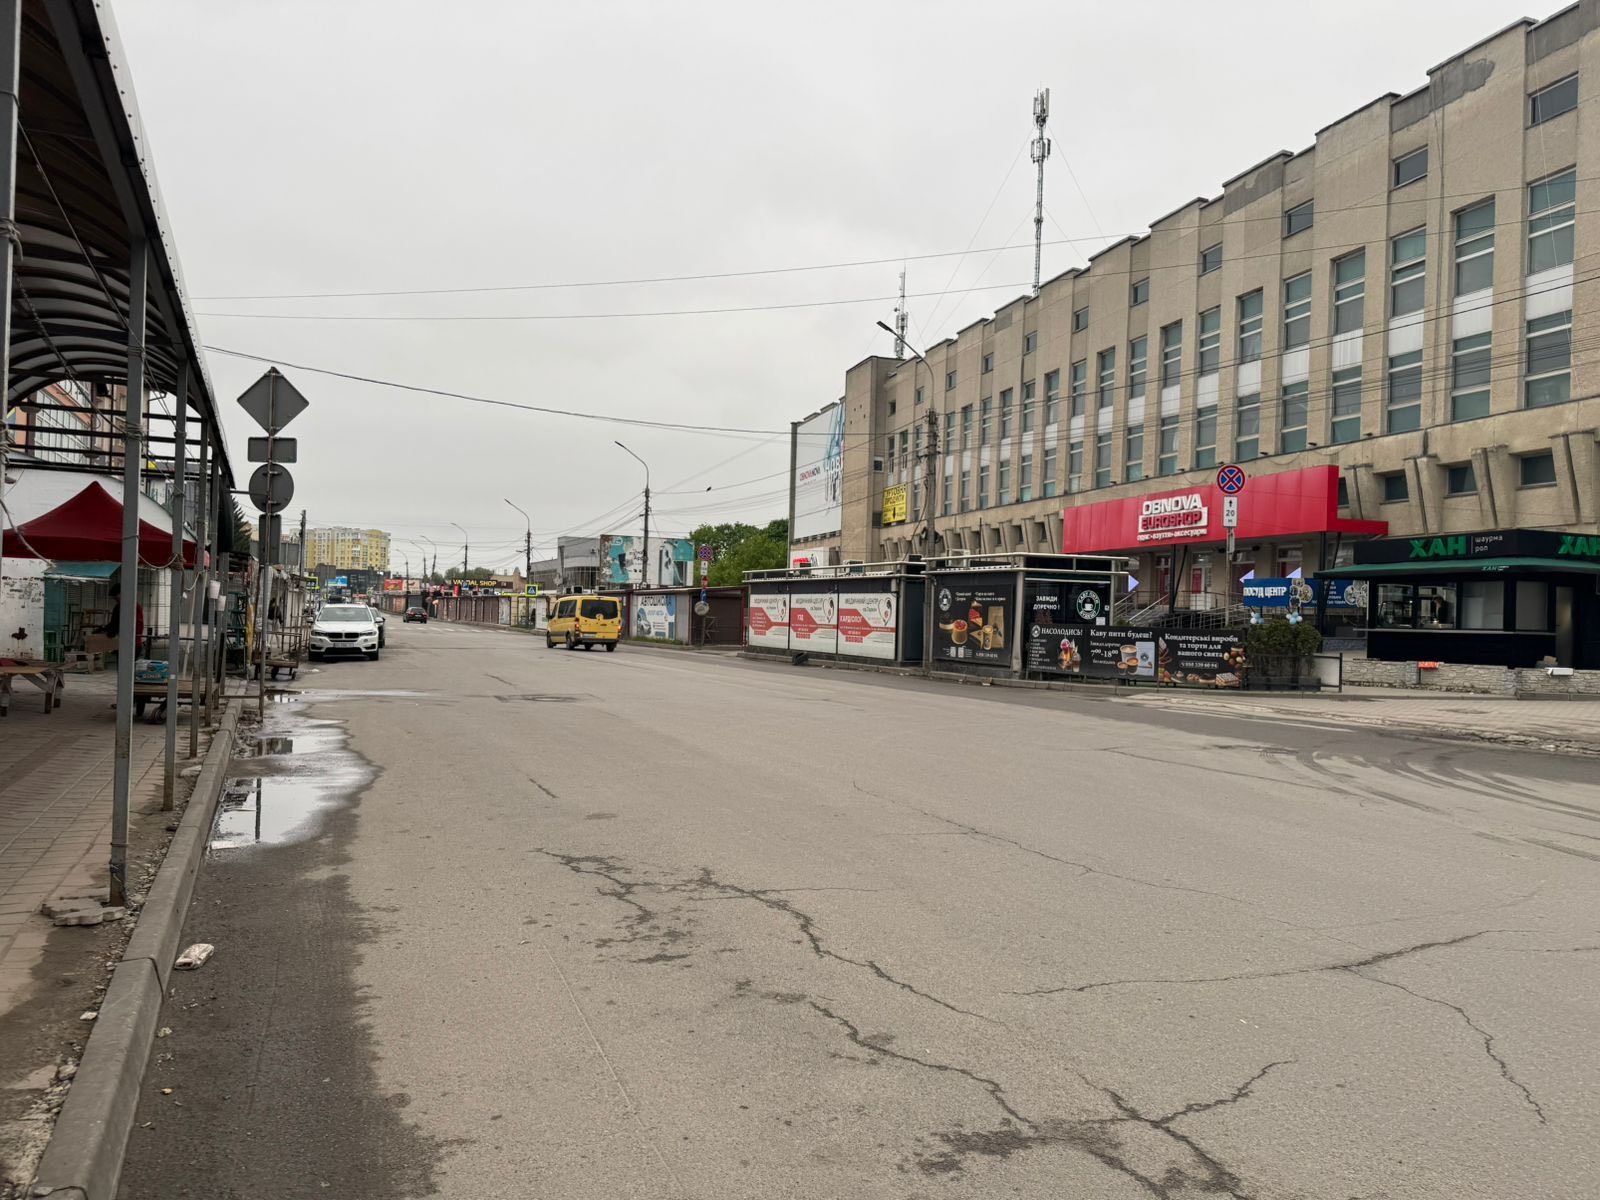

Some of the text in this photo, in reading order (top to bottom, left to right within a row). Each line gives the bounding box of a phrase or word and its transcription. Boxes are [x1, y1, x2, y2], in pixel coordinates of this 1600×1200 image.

[1142, 494, 1203, 515] OBNOVA
[1142, 511, 1203, 530] EUROSHOP
[1409, 535, 1503, 558] ХАН шаурма
[1243, 587, 1287, 598] ПОСУД ЦЕНТР
[1042, 627, 1083, 636] НАСОЛОДИСЬ!
[1090, 629, 1107, 638] Каву
[1165, 633, 1238, 643] Кондитерські вироби
